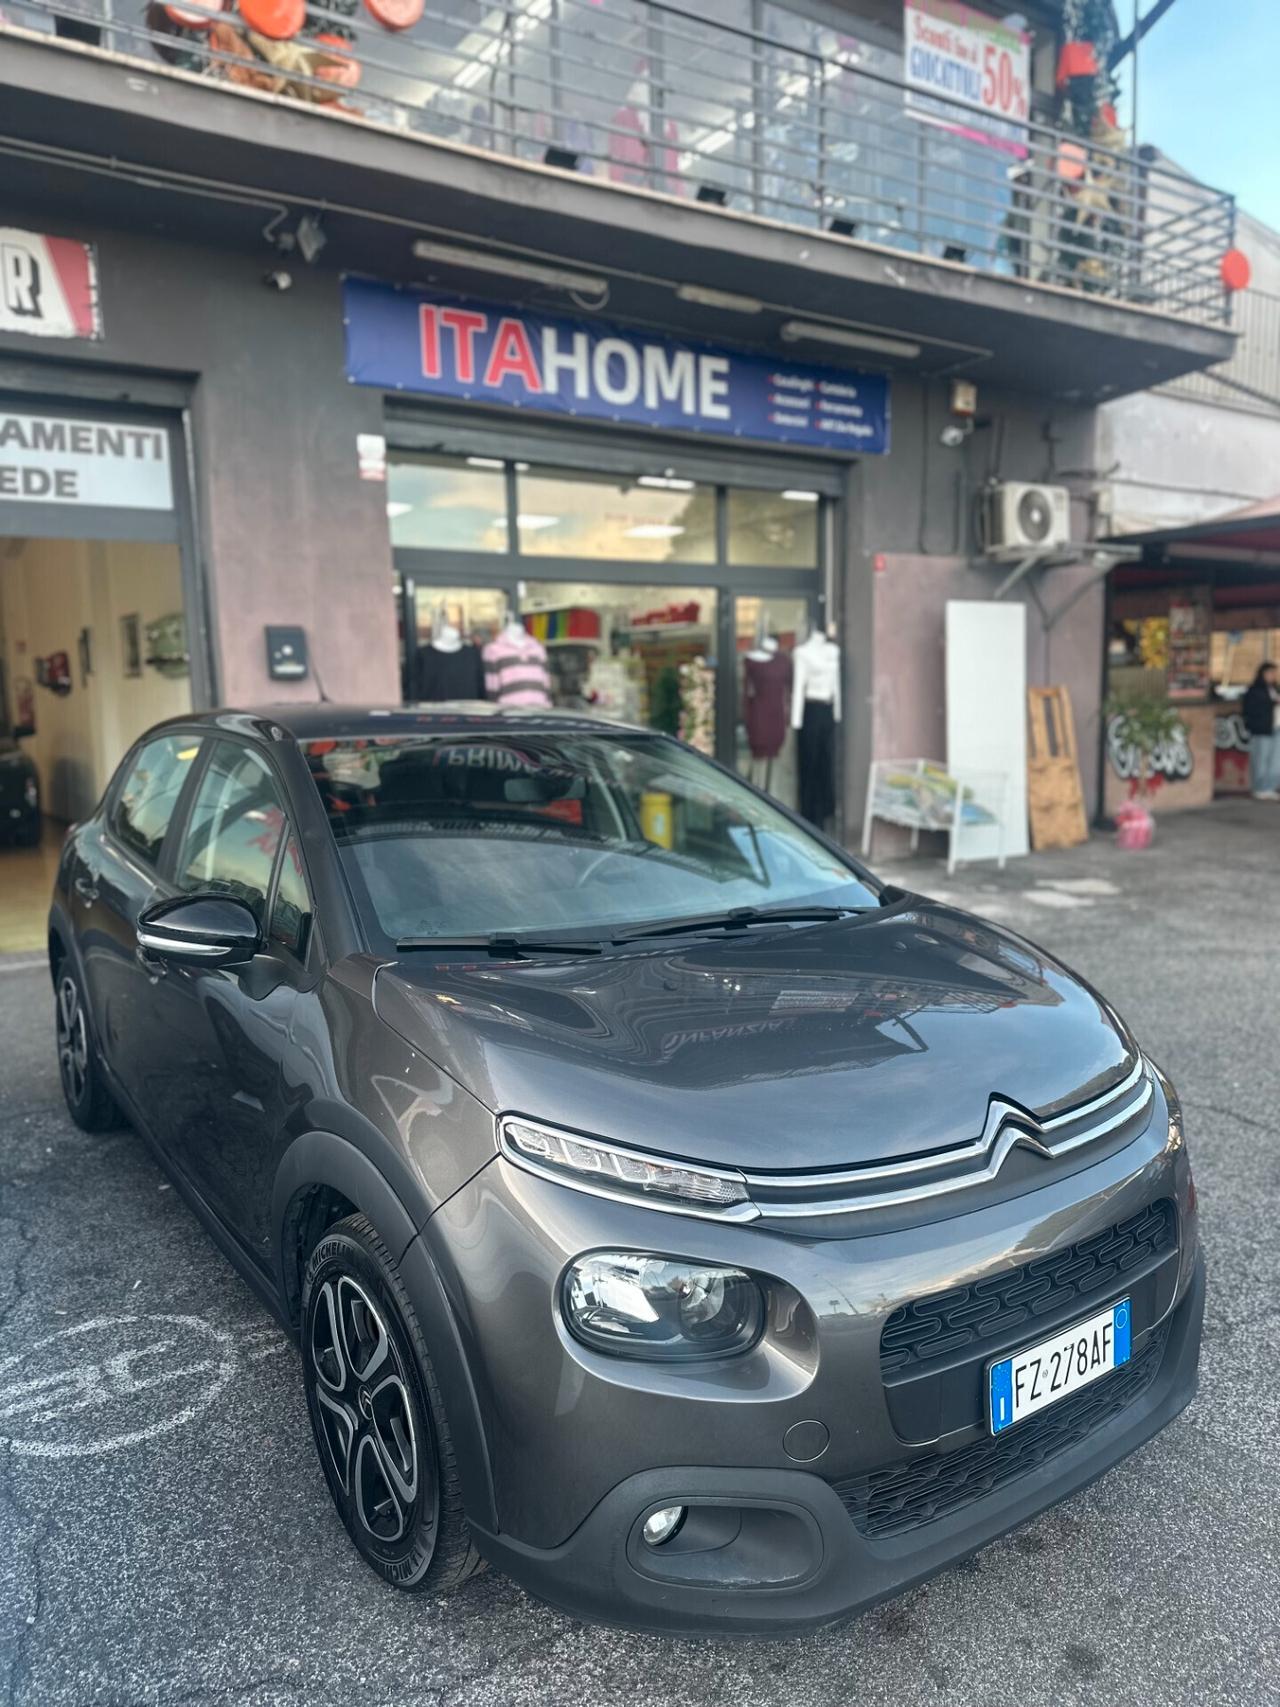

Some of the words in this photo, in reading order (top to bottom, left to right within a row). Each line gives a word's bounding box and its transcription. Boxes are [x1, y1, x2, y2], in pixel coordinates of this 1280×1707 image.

[1, 242, 43, 319] R
[420, 303, 731, 420] ITAHOME
[0, 418, 162, 460] AMENTI
